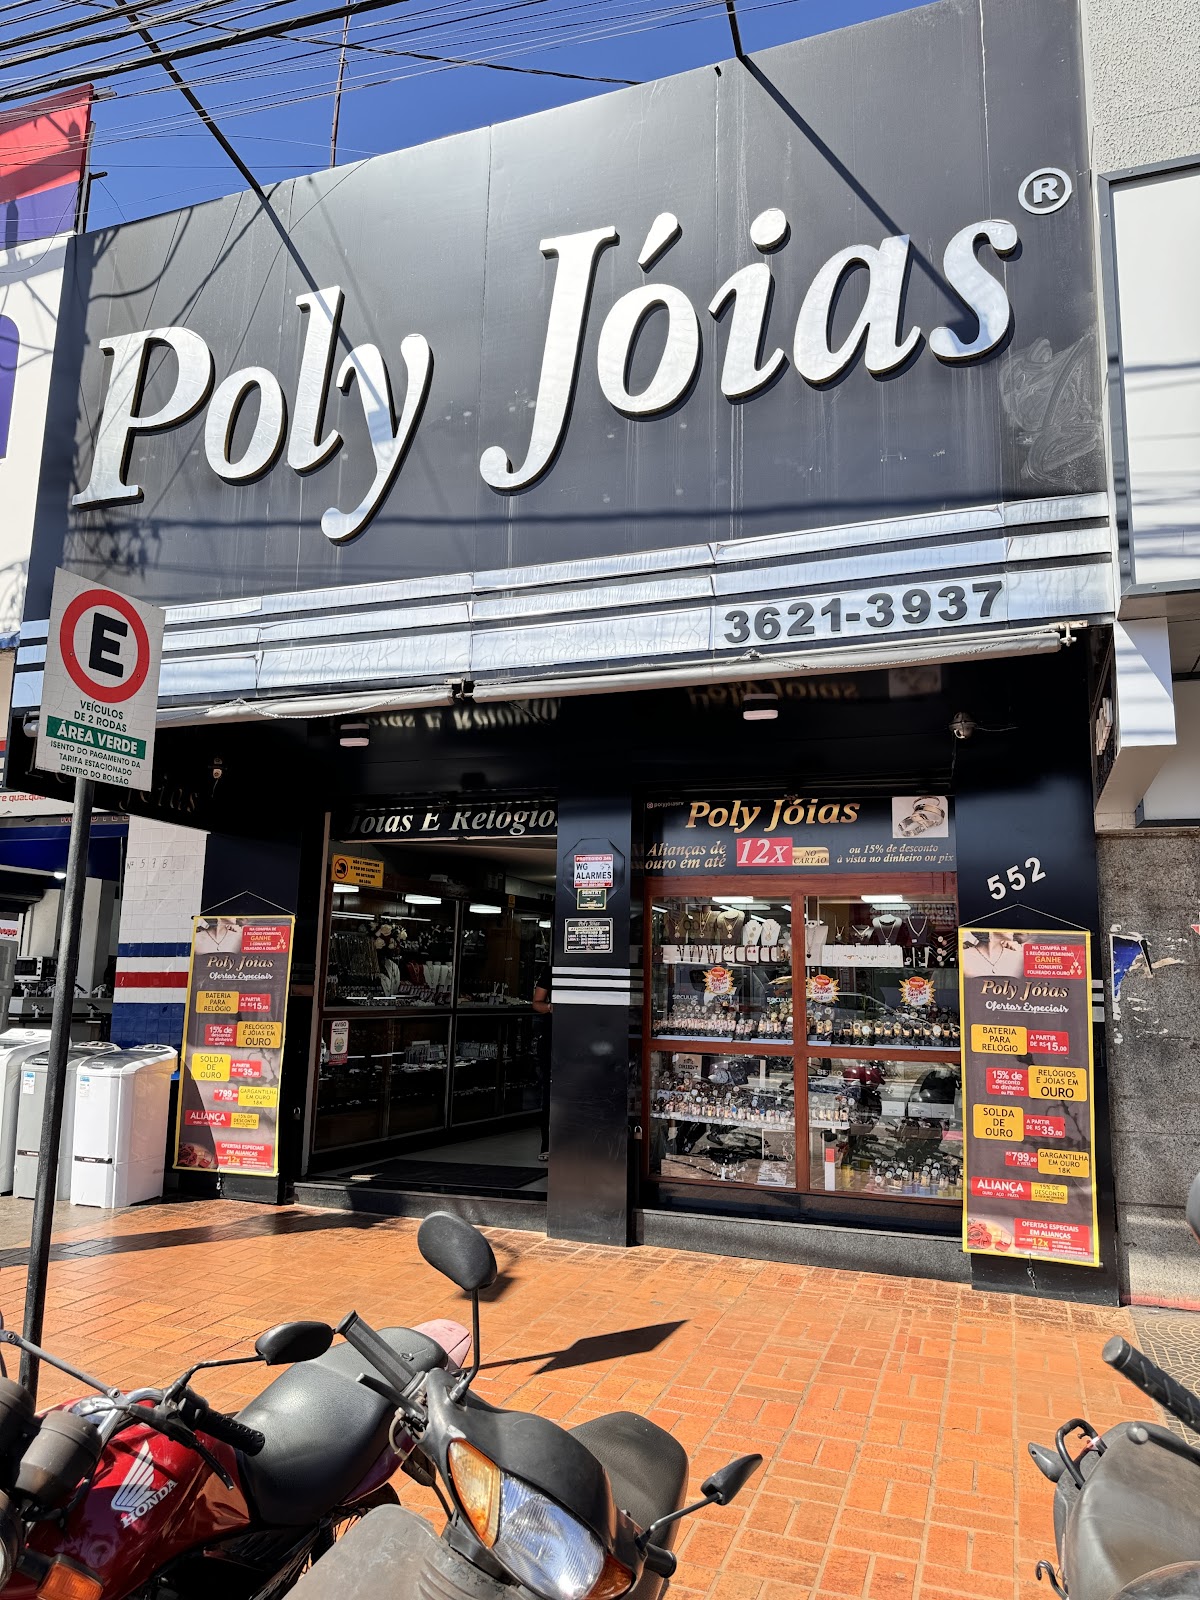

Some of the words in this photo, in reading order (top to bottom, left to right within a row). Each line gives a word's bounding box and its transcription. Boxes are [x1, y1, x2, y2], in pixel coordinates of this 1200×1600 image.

[71, 286, 431, 545] Poly
[479, 208, 1020, 494] Jóias
[724, 581, 1003, 643] 3621-3937
[89, 612, 128, 678] E
[80, 700, 124, 720] VEÍCULOS
[74, 710, 86, 721] DE
[88, 715, 94, 724] 2
[96, 717, 127, 732] RODAS
[57, 720, 94, 744] ÁREA
[98, 732, 137, 754] VERDE
[50, 740, 74, 752] ISENTO
[77, 747, 88, 755] DO
[90, 750, 130, 766] PAGAMENTO
[59, 753, 82, 764] TARIFA
[85, 759, 132, 776] ESTACIONADO
[60, 764, 88, 776] DENTRO
[102, 774, 129, 785] BOLSÃO
[419, 812, 441, 832] E
[685, 800, 761, 833] Poly
[764, 799, 860, 832] Jóias
[646, 843, 706, 858] Alianças
[710, 840, 726, 854] de
[738, 839, 790, 864] 12x
[864, 844, 884, 854] 15%
[886, 844, 897, 852] de
[899, 844, 938, 852] desconto
[645, 860, 676, 870] ouro
[680, 860, 700, 868] em
[704, 854, 726, 868] até
[794, 856, 827, 864] CARTÃO
[837, 854, 842, 864] à
[846, 855, 866, 863] vista
[884, 854, 922, 862] dinheiro
[938, 853, 954, 864] pix
[576, 872, 612, 880] ALARMES
[987, 857, 1046, 900] 552
[207, 956, 234, 971] Poly
[236, 956, 274, 972] Jóias
[210, 972, 236, 980] Ofertas
[238, 972, 273, 981] Especiais
[980, 980, 1018, 999] Poly
[1020, 981, 1070, 1001] Jóias
[986, 1001, 1022, 1012] Ofertas
[1023, 1002, 1069, 1014] Especiais
[982, 1026, 1016, 1035] BATERIA
[246, 1038, 271, 1046] OURO
[982, 1043, 1018, 1052] RELÓGIO
[992, 1071, 1010, 1080] 15%
[1011, 1072, 1022, 1080] de
[1038, 1068, 1076, 1078] RELÓGIOS
[1040, 1086, 1074, 1098] OURO
[190, 1112, 226, 1122] ALIANÇA
[983, 1108, 1014, 1118] SOLDA
[993, 1118, 1004, 1126] DE
[986, 1128, 1013, 1137] OURO
[1040, 1152, 1088, 1162] GARGANTILHA
[978, 1179, 1024, 1194] ALIANÇA
[1022, 1221, 1048, 1230] OFERTAS
[1049, 1224, 1078, 1232] ESPECIAIS
[1041, 1231, 1071, 1240] ALIANÇAS
[1032, 1238, 1048, 1247] 12x
[121, 1478, 178, 1529] HONDA
